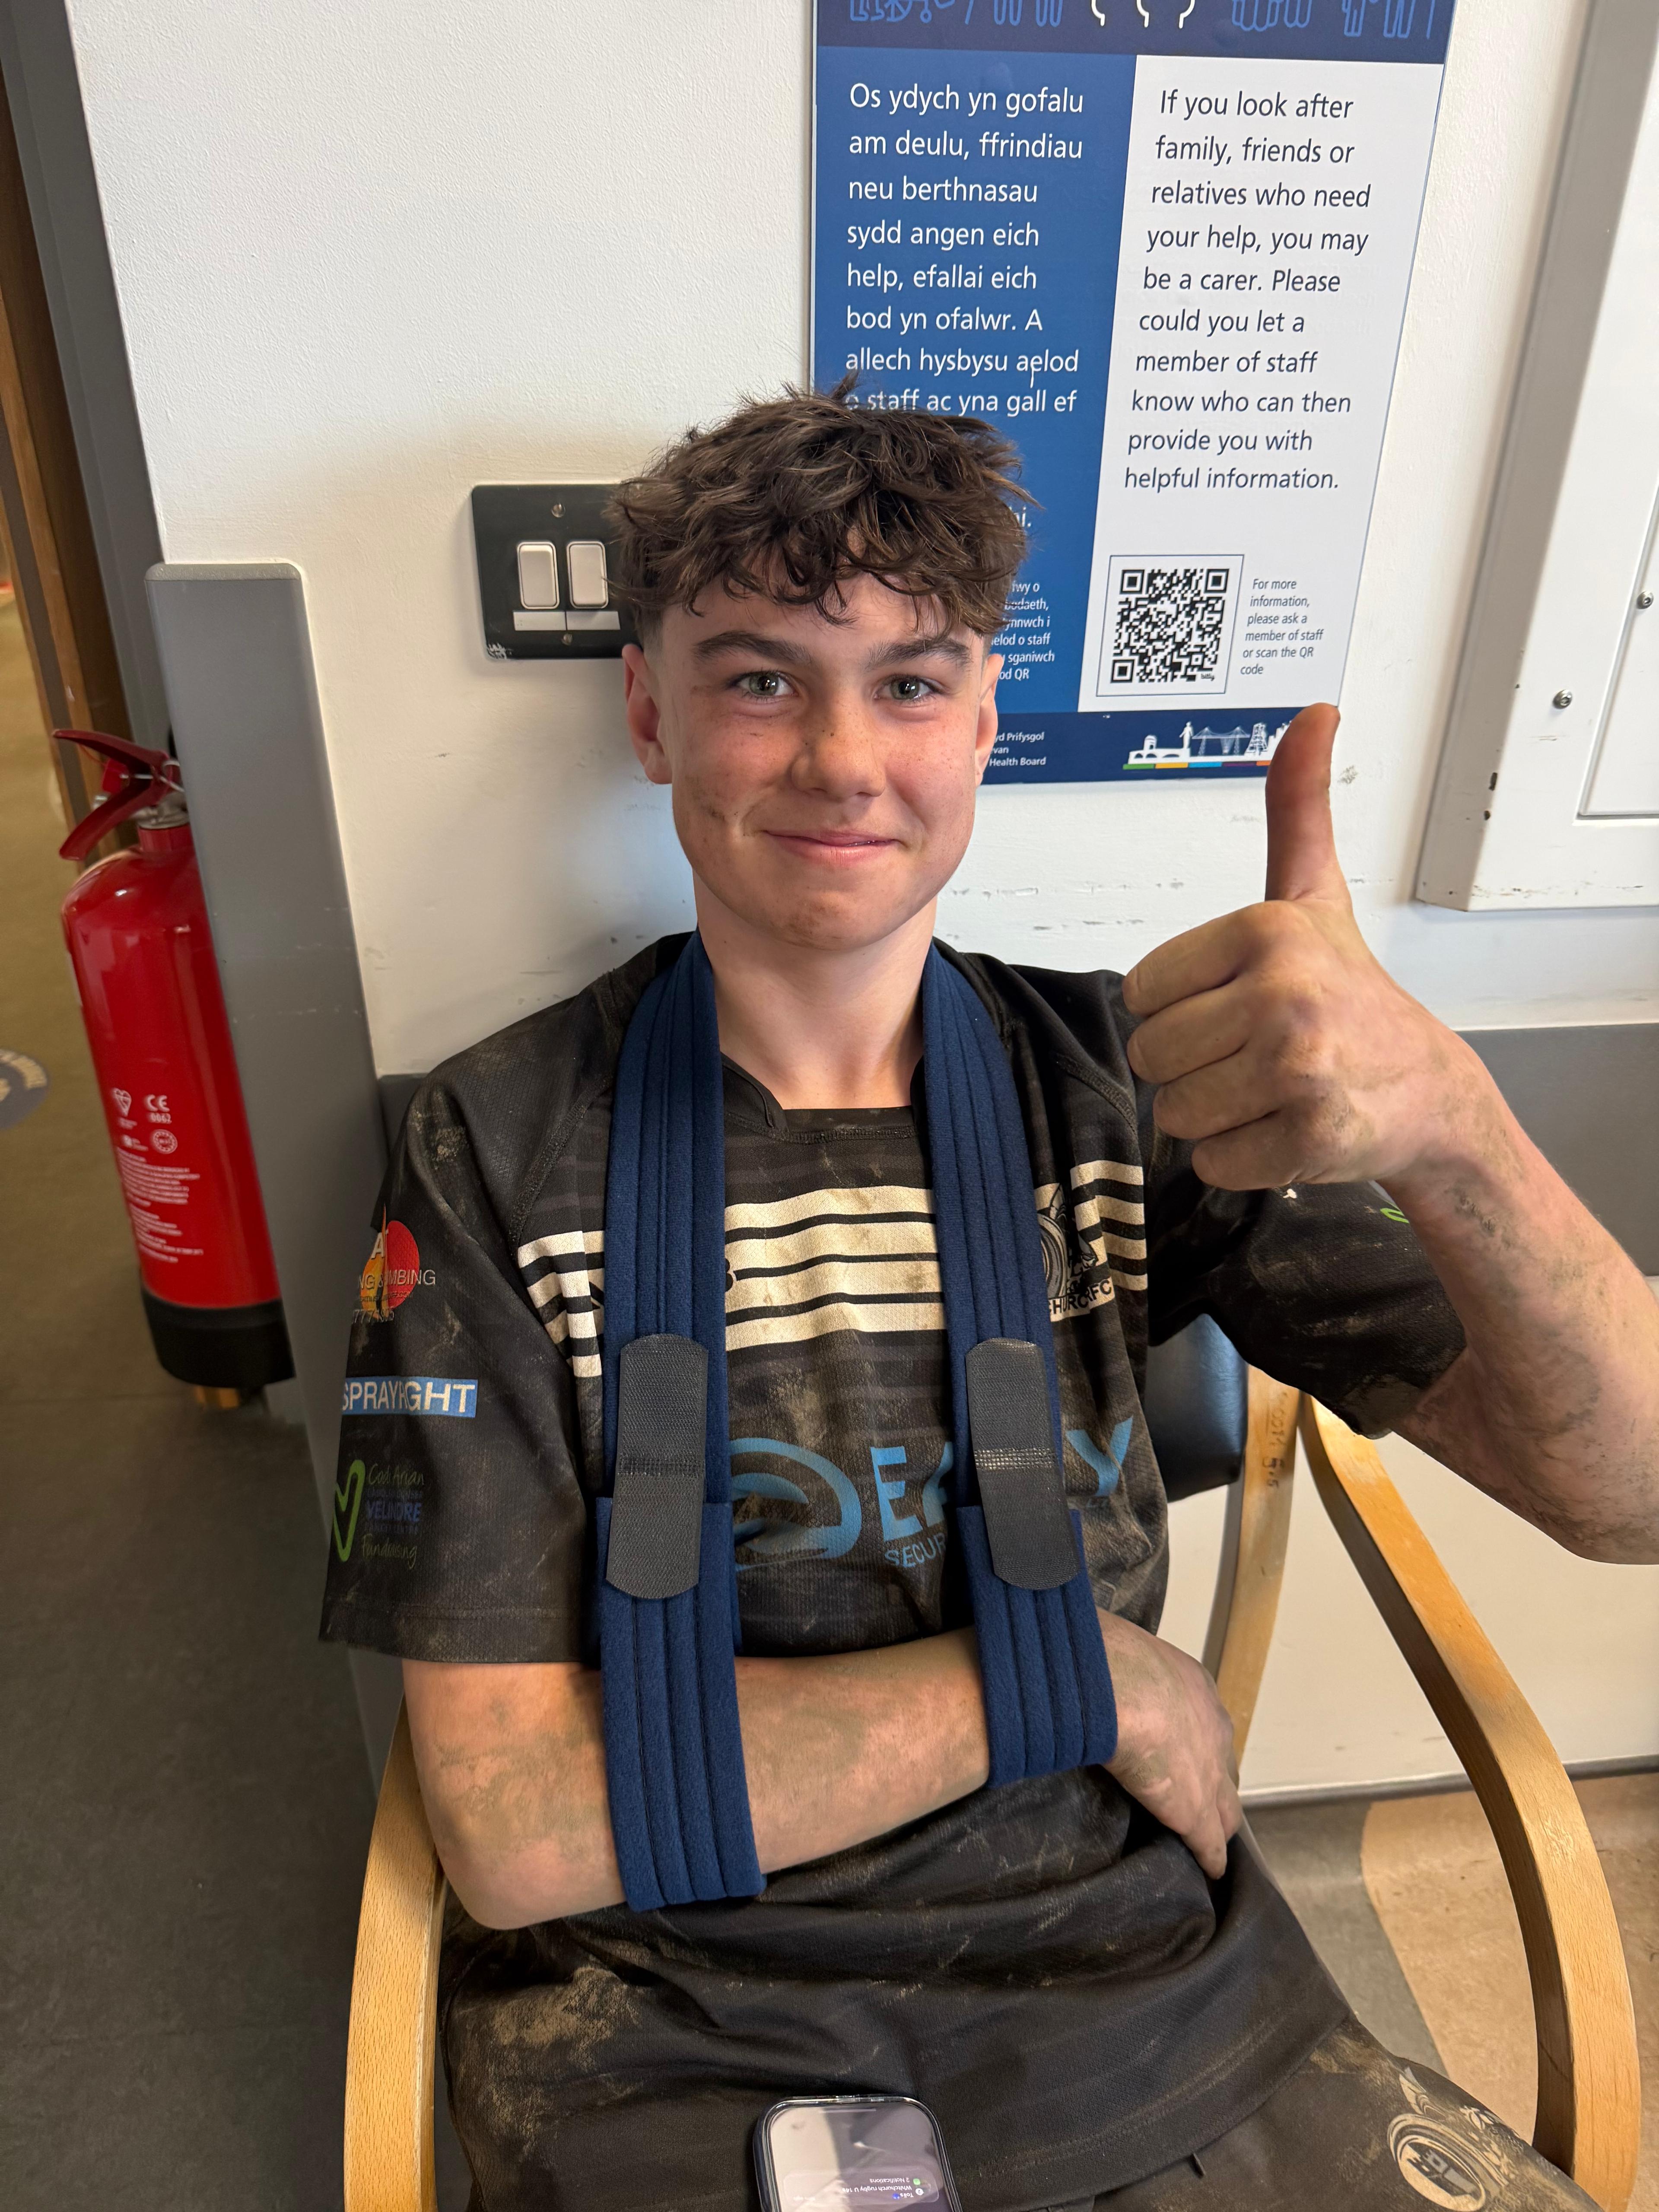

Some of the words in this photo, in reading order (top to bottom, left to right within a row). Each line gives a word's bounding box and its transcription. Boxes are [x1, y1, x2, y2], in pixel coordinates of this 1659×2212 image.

[850, 83, 880, 108] Os
[889, 83, 959, 115] ydych
[968, 92, 996, 117] yn
[1006, 86, 1083, 118] gofalu
[1161, 89, 1178, 114] If
[1183, 97, 1228, 121] you
[1237, 90, 1287, 116] look
[1296, 93, 1354, 118] after
[849, 136, 886, 154] am
[896, 130, 969, 160] deulu,
[979, 131, 1082, 159] ffrindiau
[1155, 134, 1232, 166] family,
[1242, 137, 1321, 162] friends
[1330, 146, 1355, 163] or
[849, 181, 893, 200] neu
[903, 175, 1037, 202] berthnasau
[1152, 180, 1247, 205] relatives
[1255, 182, 1305, 206] who
[1314, 184, 1371, 207] need
[848, 219, 901, 250] sydd
[910, 227, 984, 251] angen
[993, 222, 1039, 246] eich
[1146, 230, 1200, 253] your
[1207, 224, 1261, 254] help,
[1270, 232, 1313, 255] you
[1321, 233, 1369, 256] may
[848, 263, 903, 293] help,
[913, 264, 982, 288] efallai
[991, 265, 1036, 289] eich
[1144, 266, 1171, 289] be
[1179, 273, 1191, 289] a
[1201, 274, 1262, 291] carer.
[1272, 268, 1340, 292] Please
[847, 305, 891, 329] bod
[900, 313, 927, 335] yn
[936, 307, 1016, 330] ofalwr.
[1025, 309, 1042, 331] A
[1139, 308, 1200, 331] could
[1207, 316, 1249, 337] you
[1257, 309, 1285, 332] let
[1292, 317, 1304, 332] a
[846, 347, 910, 370] allech
[920, 348, 1007, 377] hysbysu
[1136, 350, 1230, 372] member
[1236, 350, 1261, 372] of
[1266, 351, 1318, 373] staff
[867, 389, 920, 410] staff
[926, 394, 951, 411] ac
[958, 394, 998, 416] yna
[1006, 389, 1046, 417] gall
[1054, 389, 1078, 412] ef
[1132, 389, 1195, 411] know
[1201, 390, 1249, 412] who
[1257, 397, 1294, 412] can
[1302, 391, 1351, 413] then
[1128, 429, 1210, 455] provide
[1217, 435, 1257, 456] you
[1266, 429, 1312, 450] with
[1125, 467, 1200, 493] helpful
[1207, 467, 1338, 488] information.
[1033, 583, 1040, 592] o
[1252, 578, 1269, 589] For
[1271, 581, 1297, 589] more
[1004, 597, 1049, 611] bodaeth,
[1250, 595, 1309, 607] information,
[1004, 616, 1044, 631] ynnwch
[1046, 617, 1050, 627] i
[1247, 613, 1279, 626] please
[1281, 613, 1299, 624] ask
[1301, 615, 1307, 624] a
[993, 633, 1016, 645] elod
[1018, 636, 1025, 645] o
[1027, 632, 1051, 645] staff
[1245, 630, 1285, 641] member
[1288, 629, 1300, 641] of
[1300, 629, 1324, 641] staff
[1008, 650, 1055, 665] sganiwch
[1243, 649, 1253, 658] or
[1255, 649, 1278, 658] scan
[1281, 646, 1297, 657] the
[1299, 647, 1314, 658] QR
[998, 667, 1012, 680] od
[1014, 667, 1030, 681] QR
[1240, 664, 1264, 675] code
[1007, 731, 1045, 743] Prifysgol
[989, 757, 1018, 766] Health
[1020, 756, 1047, 766] Board
[145, 1094, 170, 1112] CE
